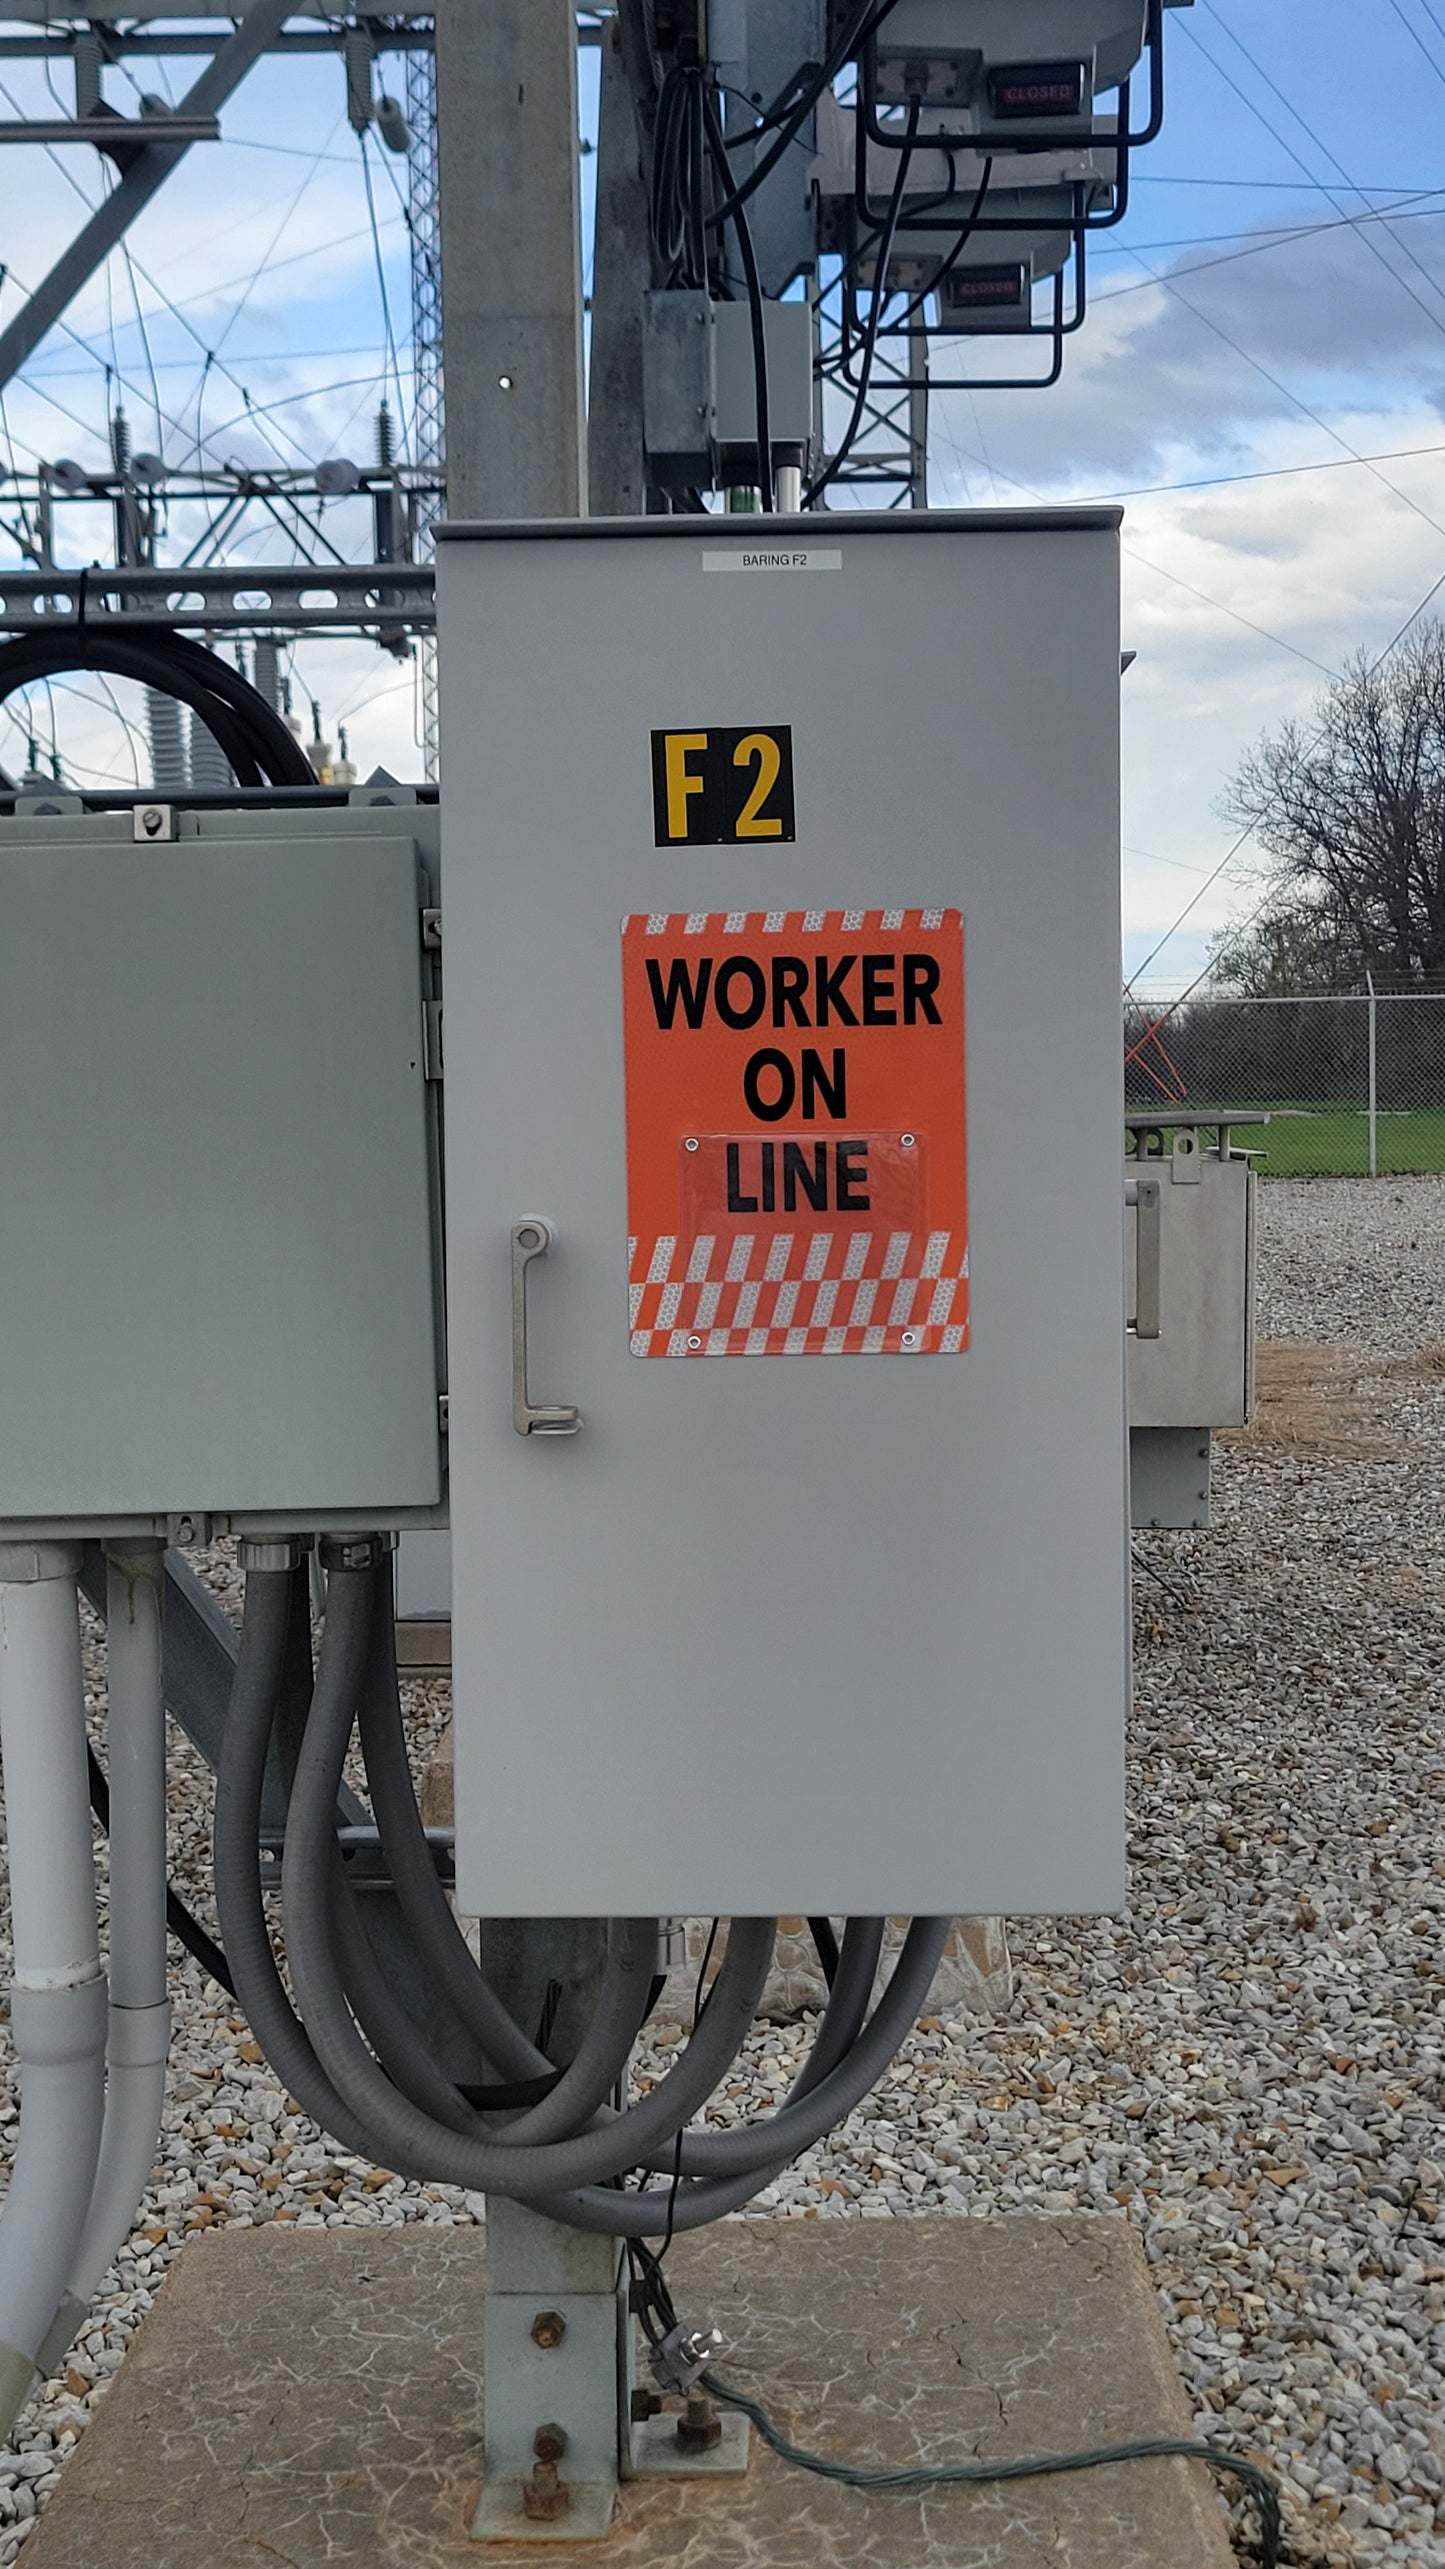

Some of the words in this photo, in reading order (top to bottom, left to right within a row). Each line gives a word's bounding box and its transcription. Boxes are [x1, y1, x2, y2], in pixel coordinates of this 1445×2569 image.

[1007, 84, 1070, 100] CLOSED
[743, 554, 789, 566] BARING
[792, 554, 807, 565] F2
[645, 953, 943, 1031] WORKER
[743, 1047, 847, 1122] ON
[726, 1140, 871, 1214] LINE
